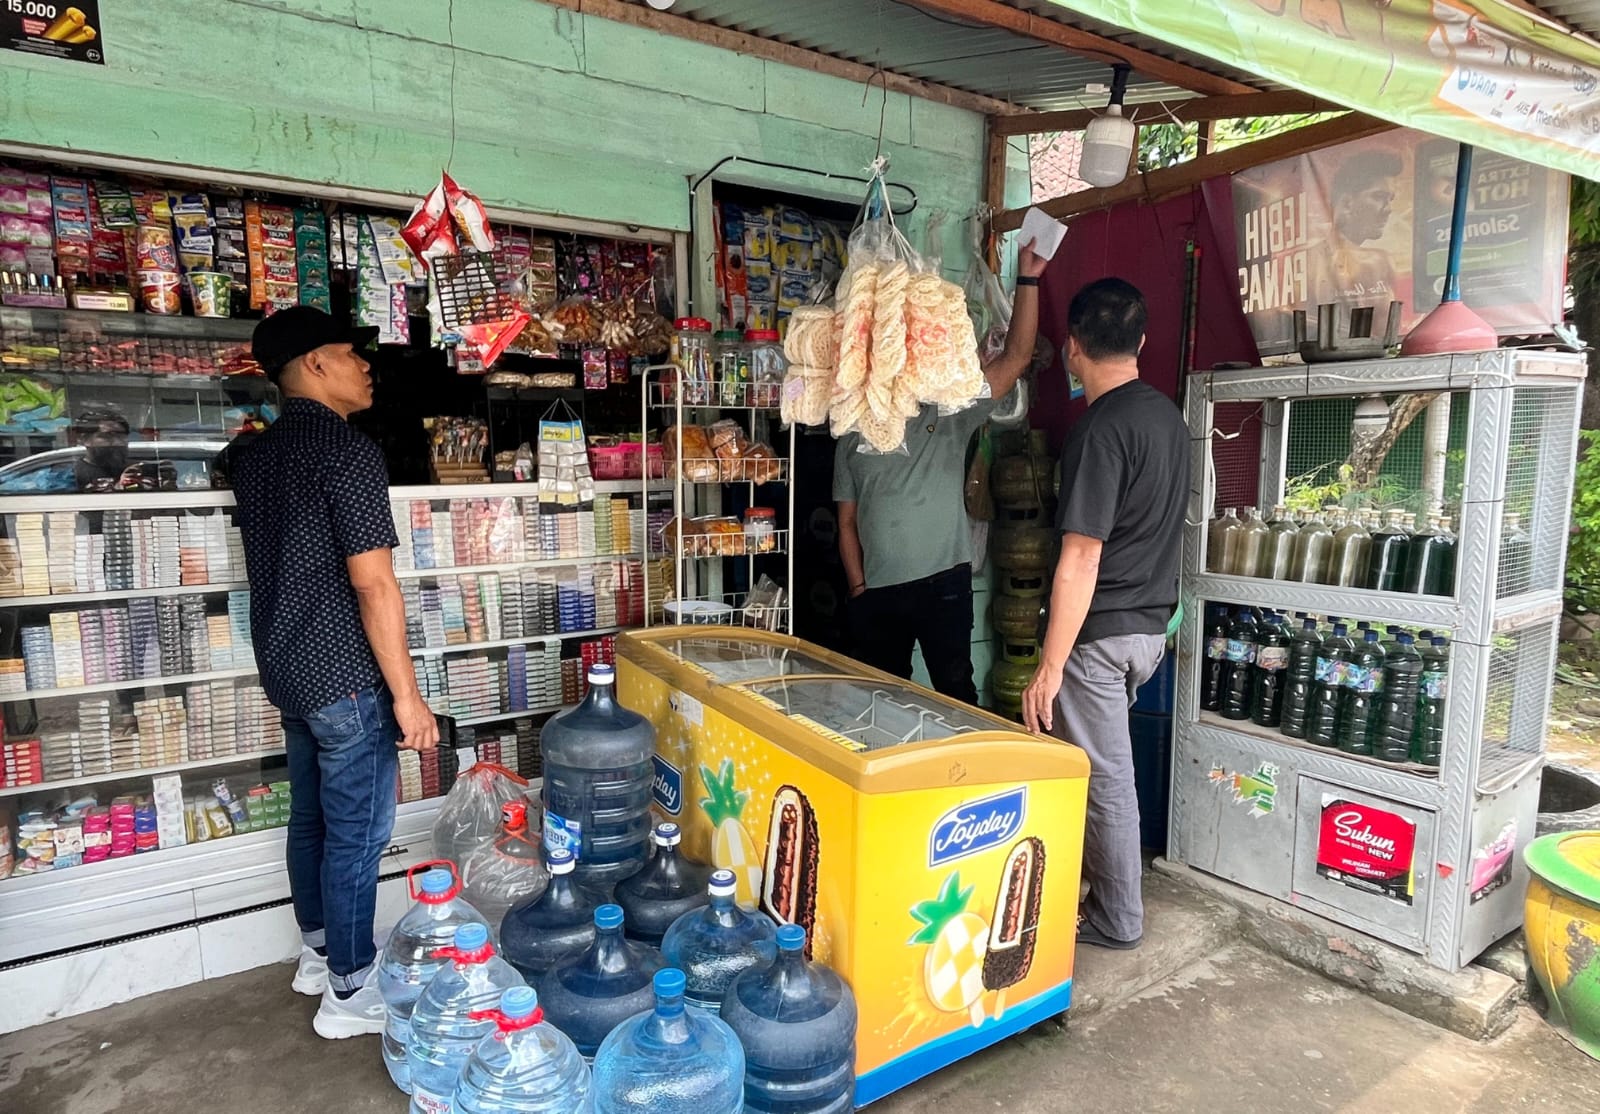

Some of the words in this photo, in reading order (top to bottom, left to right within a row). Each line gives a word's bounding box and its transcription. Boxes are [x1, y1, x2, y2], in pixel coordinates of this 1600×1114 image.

[8, 0, 56, 19] 15.000
[1470, 72, 1497, 97] DANA
[936, 810, 1017, 852] Joyday
[1334, 811, 1395, 851] Sukun
[1368, 847, 1393, 860] NEW
